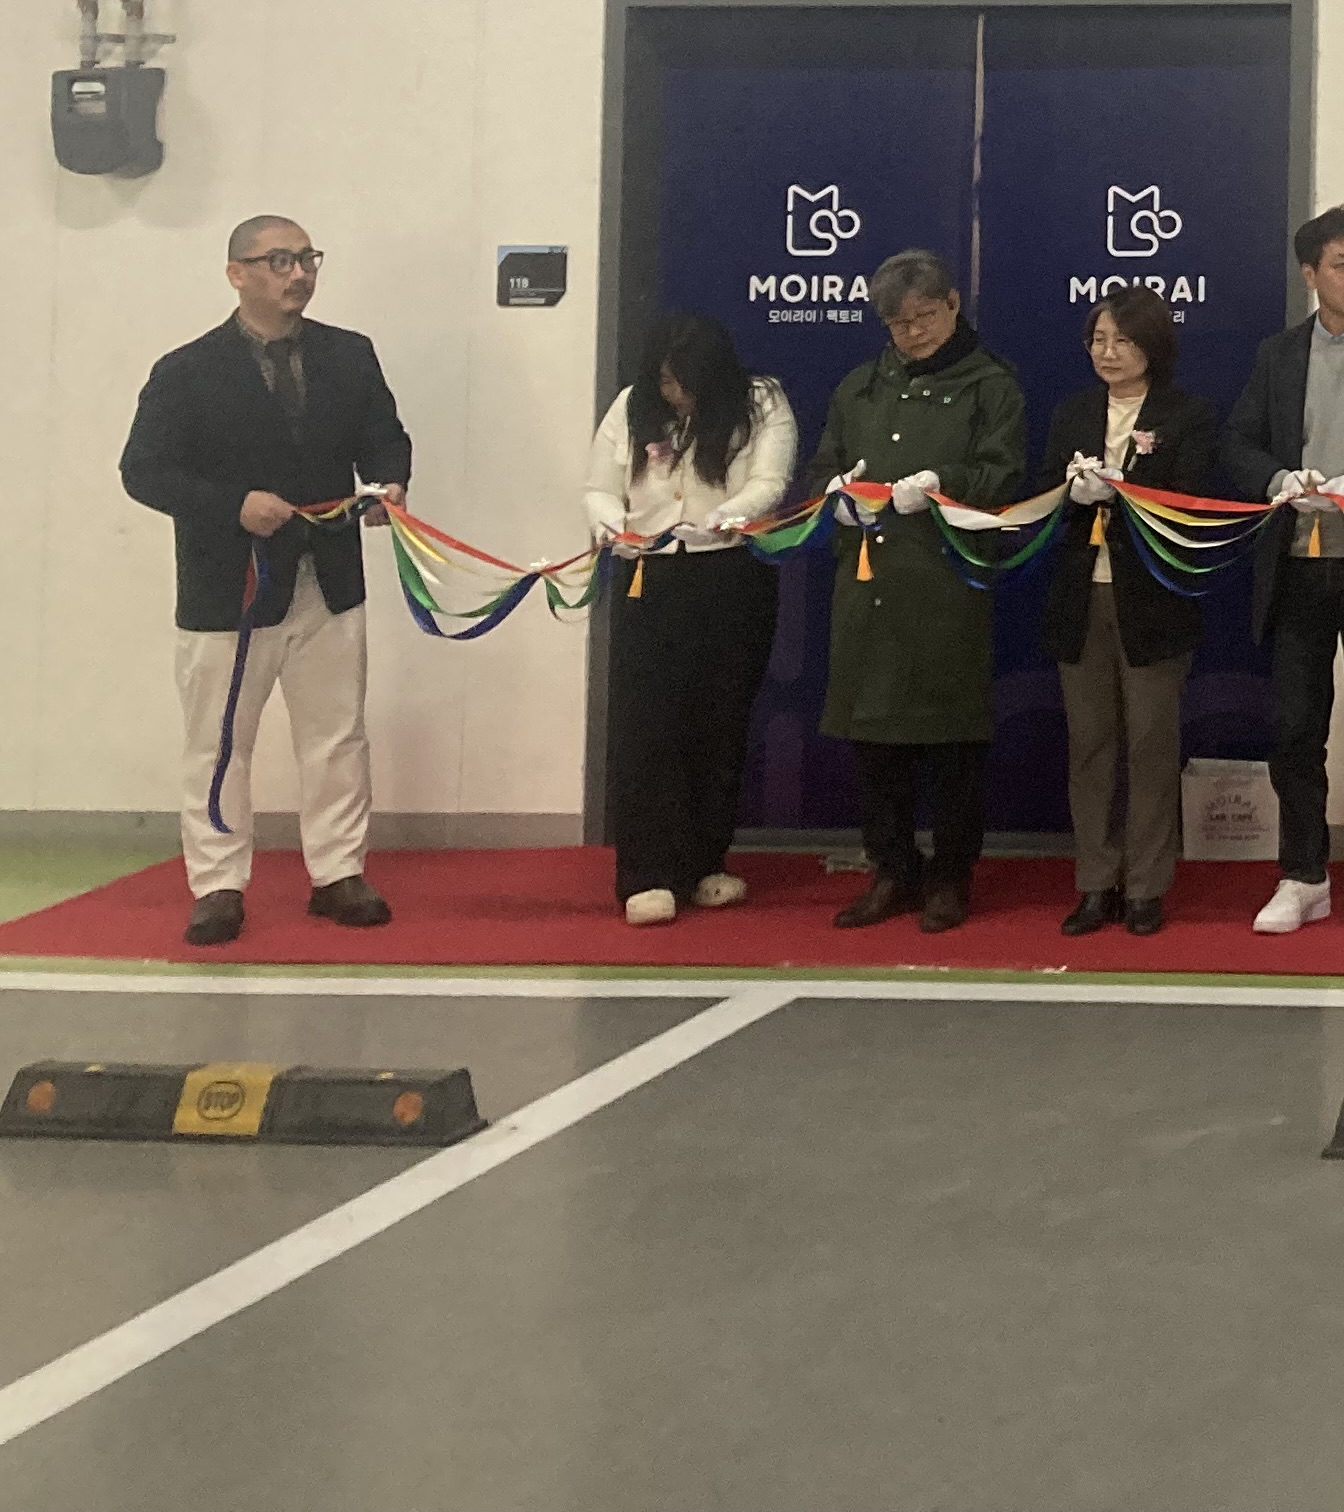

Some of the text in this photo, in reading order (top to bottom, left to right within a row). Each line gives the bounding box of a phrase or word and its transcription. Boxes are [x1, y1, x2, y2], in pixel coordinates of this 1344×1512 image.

[749, 274, 870, 303] MOIRA
[768, 309, 863, 323] 모이라이 팩토리
